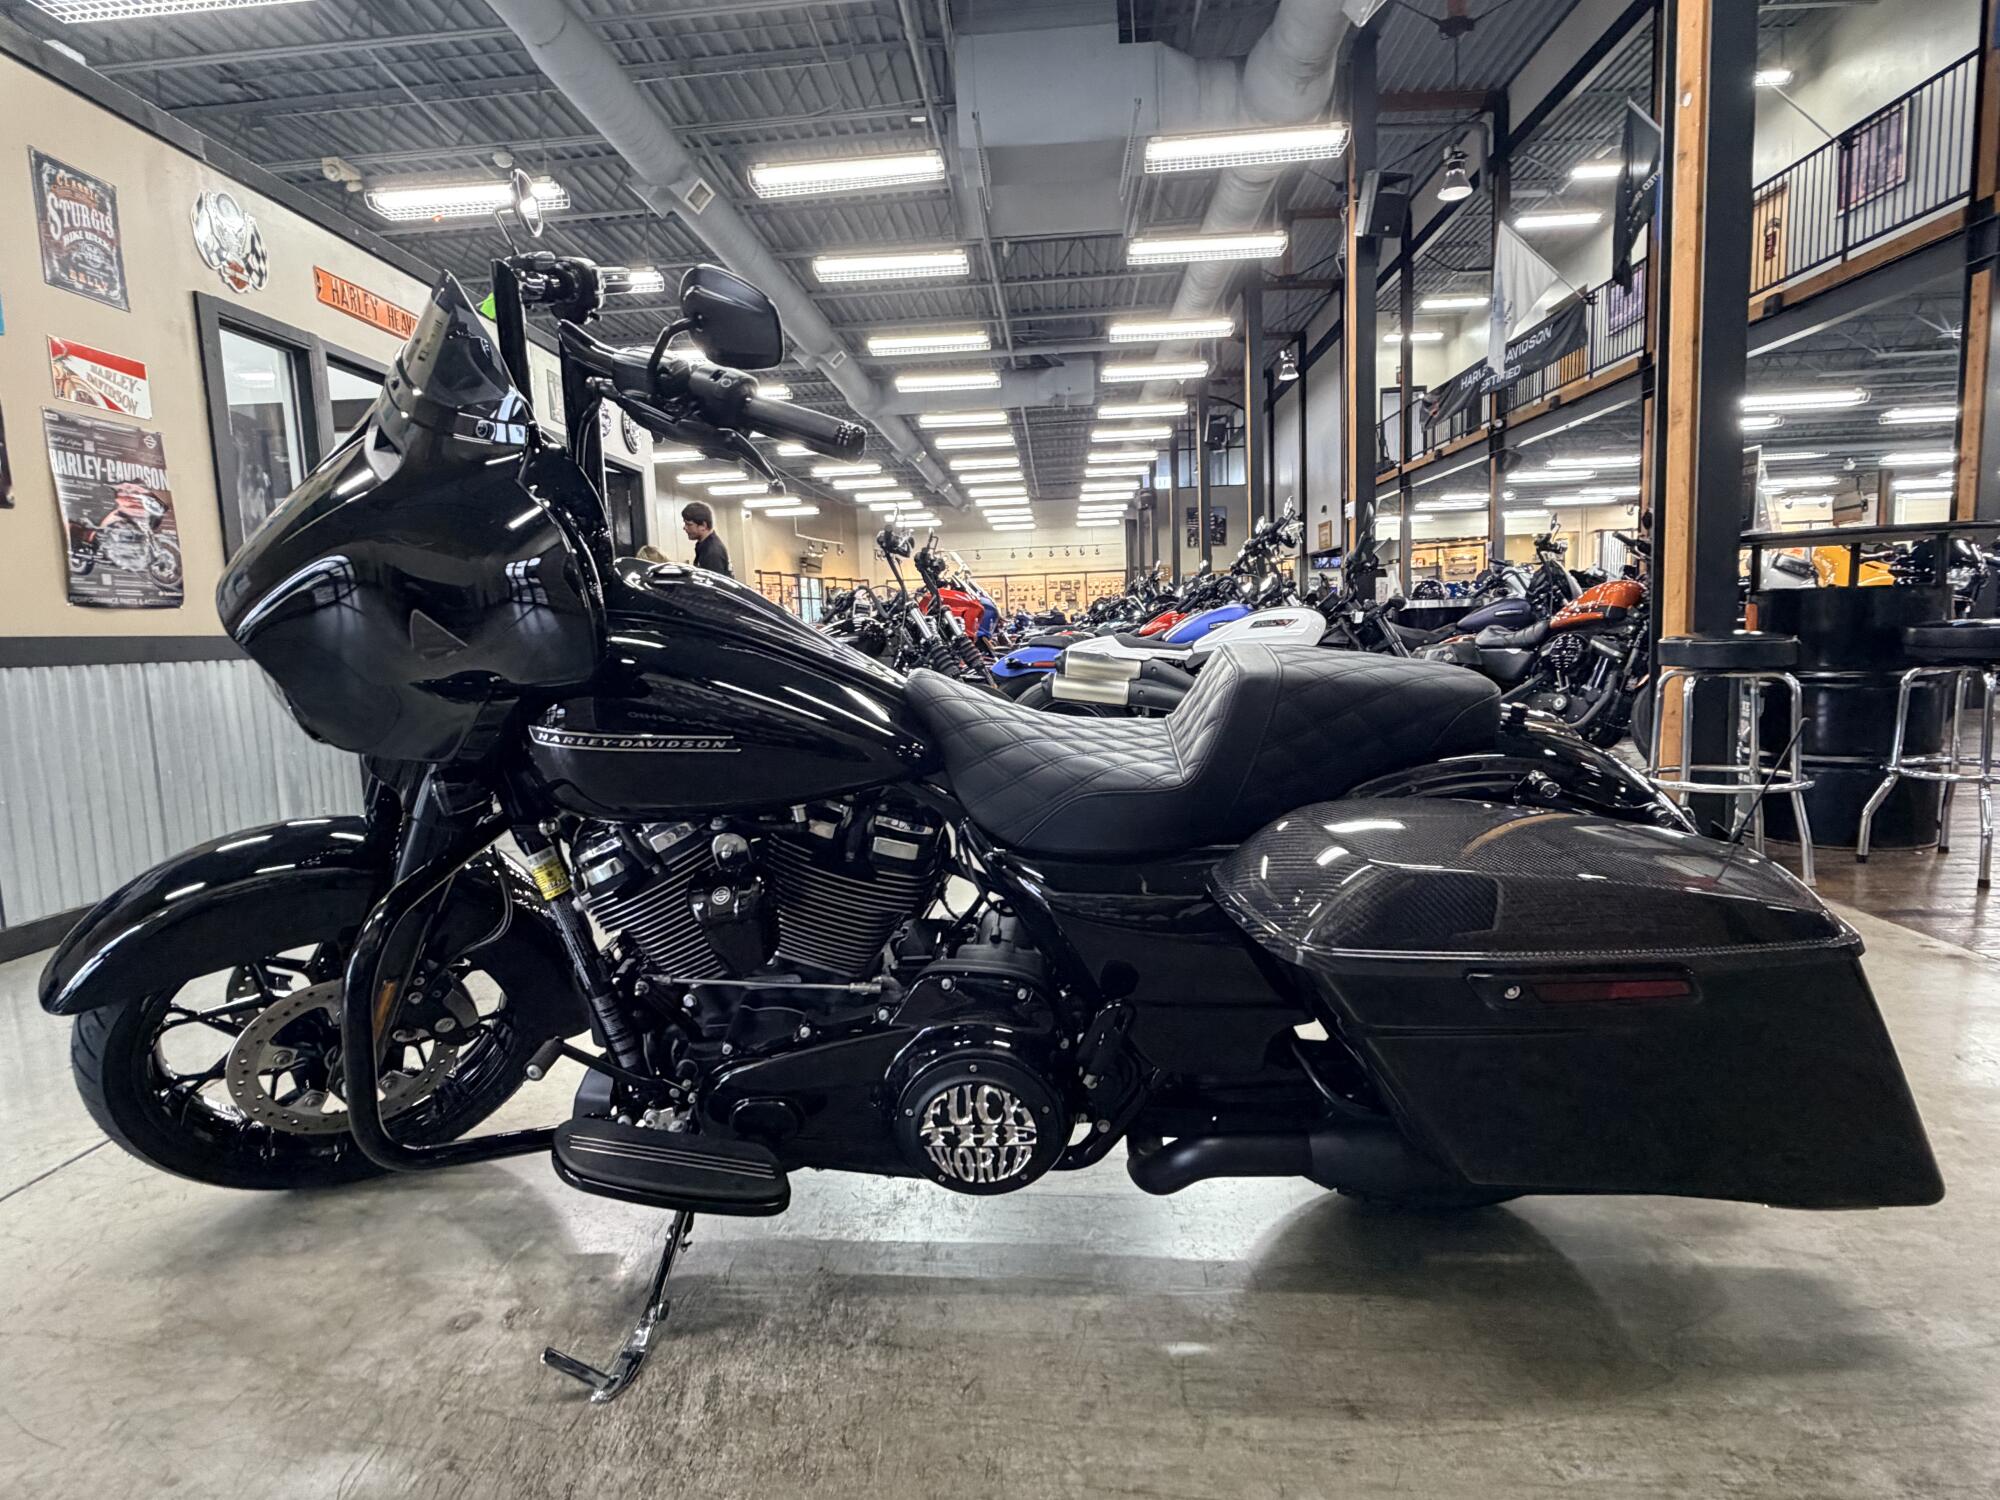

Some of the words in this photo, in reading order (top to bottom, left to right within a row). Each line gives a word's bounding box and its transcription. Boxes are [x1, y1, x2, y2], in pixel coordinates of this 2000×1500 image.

[47, 192, 114, 241] STURGIS
[331, 279, 379, 321] HARLEY
[87, 372, 139, 415] DAVIDSON
[537, 731, 727, 748] HARLEY-DAVIDSON
[921, 1084, 1036, 1129] FUCK
[919, 1124, 1037, 1146] THE
[924, 1145, 1033, 1183] WORLD
